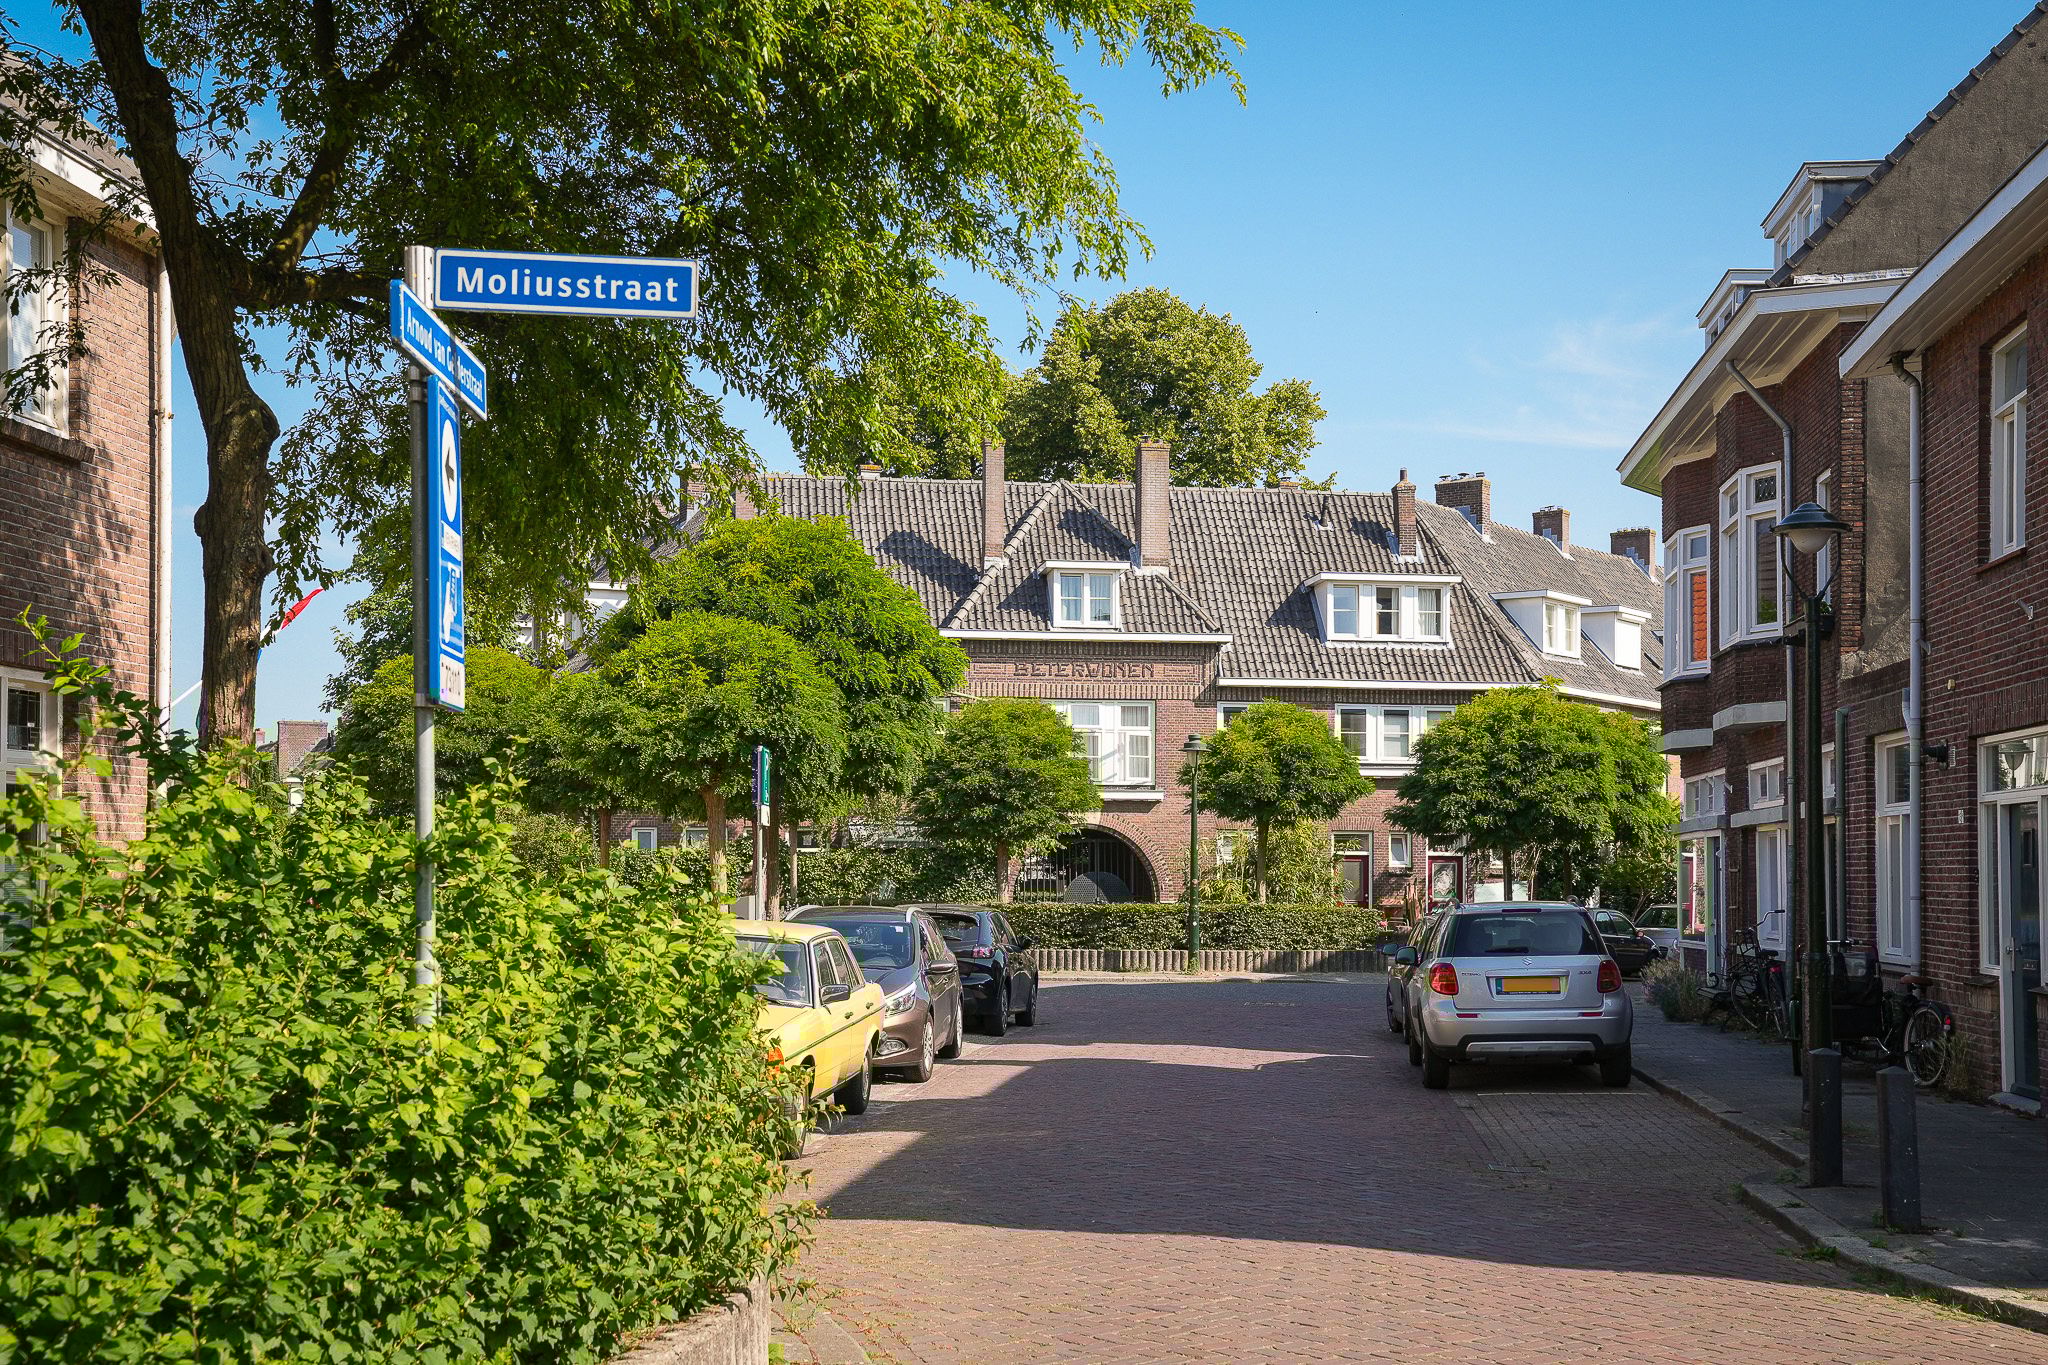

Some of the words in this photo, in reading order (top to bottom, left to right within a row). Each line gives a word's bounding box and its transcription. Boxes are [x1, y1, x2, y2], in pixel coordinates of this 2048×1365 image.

[456, 266, 679, 303] Moliusstraat
[406, 306, 433, 354] Arnoud
[434, 338, 446, 367] van
